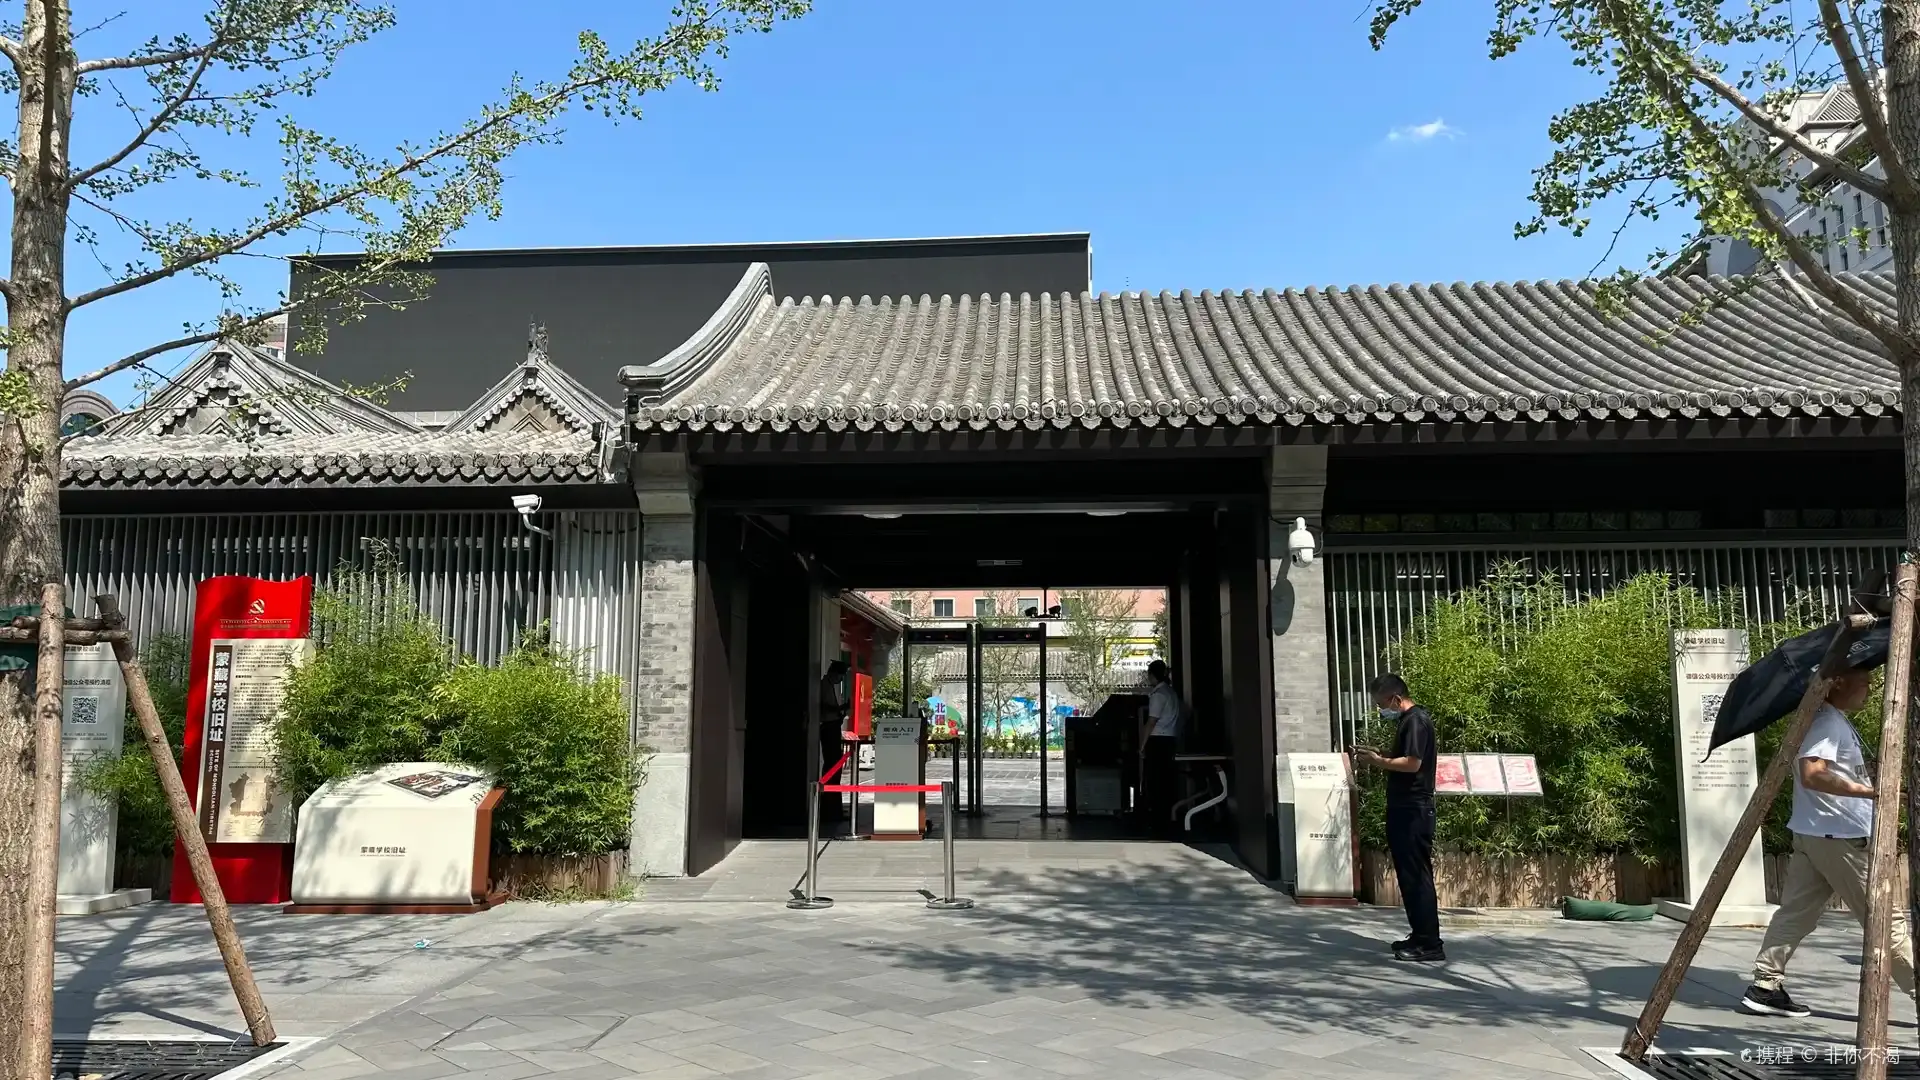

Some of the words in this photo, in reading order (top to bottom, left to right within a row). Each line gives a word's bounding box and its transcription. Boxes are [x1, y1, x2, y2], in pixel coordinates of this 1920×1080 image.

[209, 652, 230, 742] 蒙藏学校旧址
